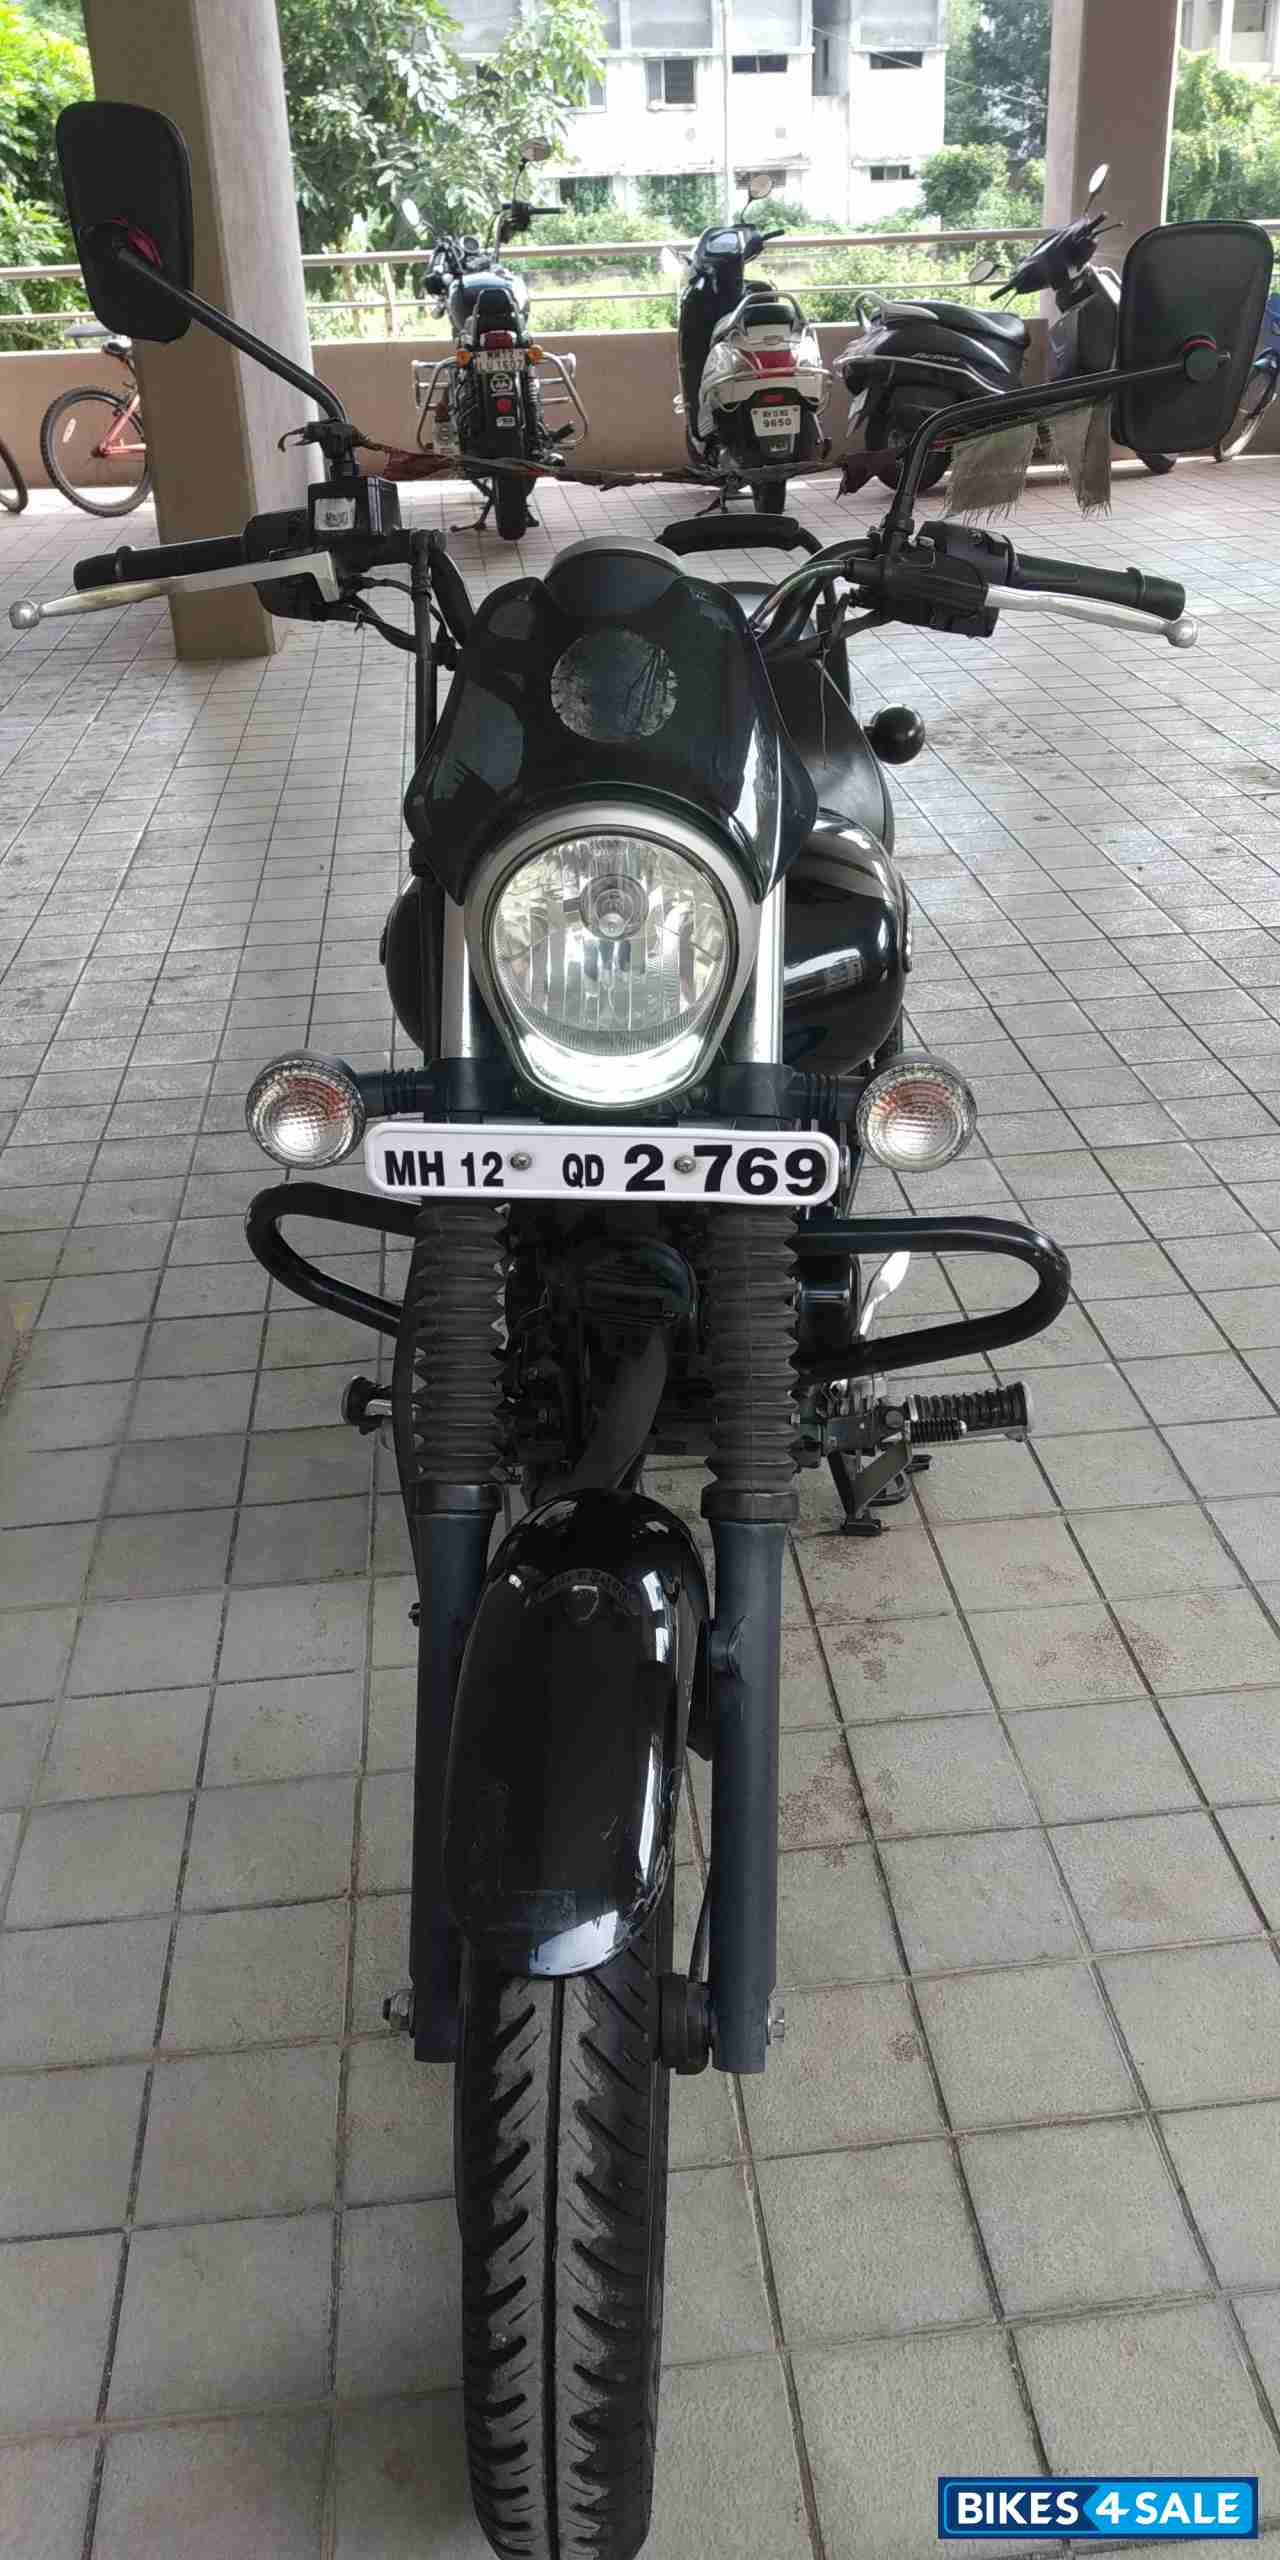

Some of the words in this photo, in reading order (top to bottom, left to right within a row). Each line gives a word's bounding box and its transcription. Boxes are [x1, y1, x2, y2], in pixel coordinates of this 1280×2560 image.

[384, 1150, 446, 1187] MH
[460, 1151, 504, 1188] 12
[562, 1153, 605, 1189] QD
